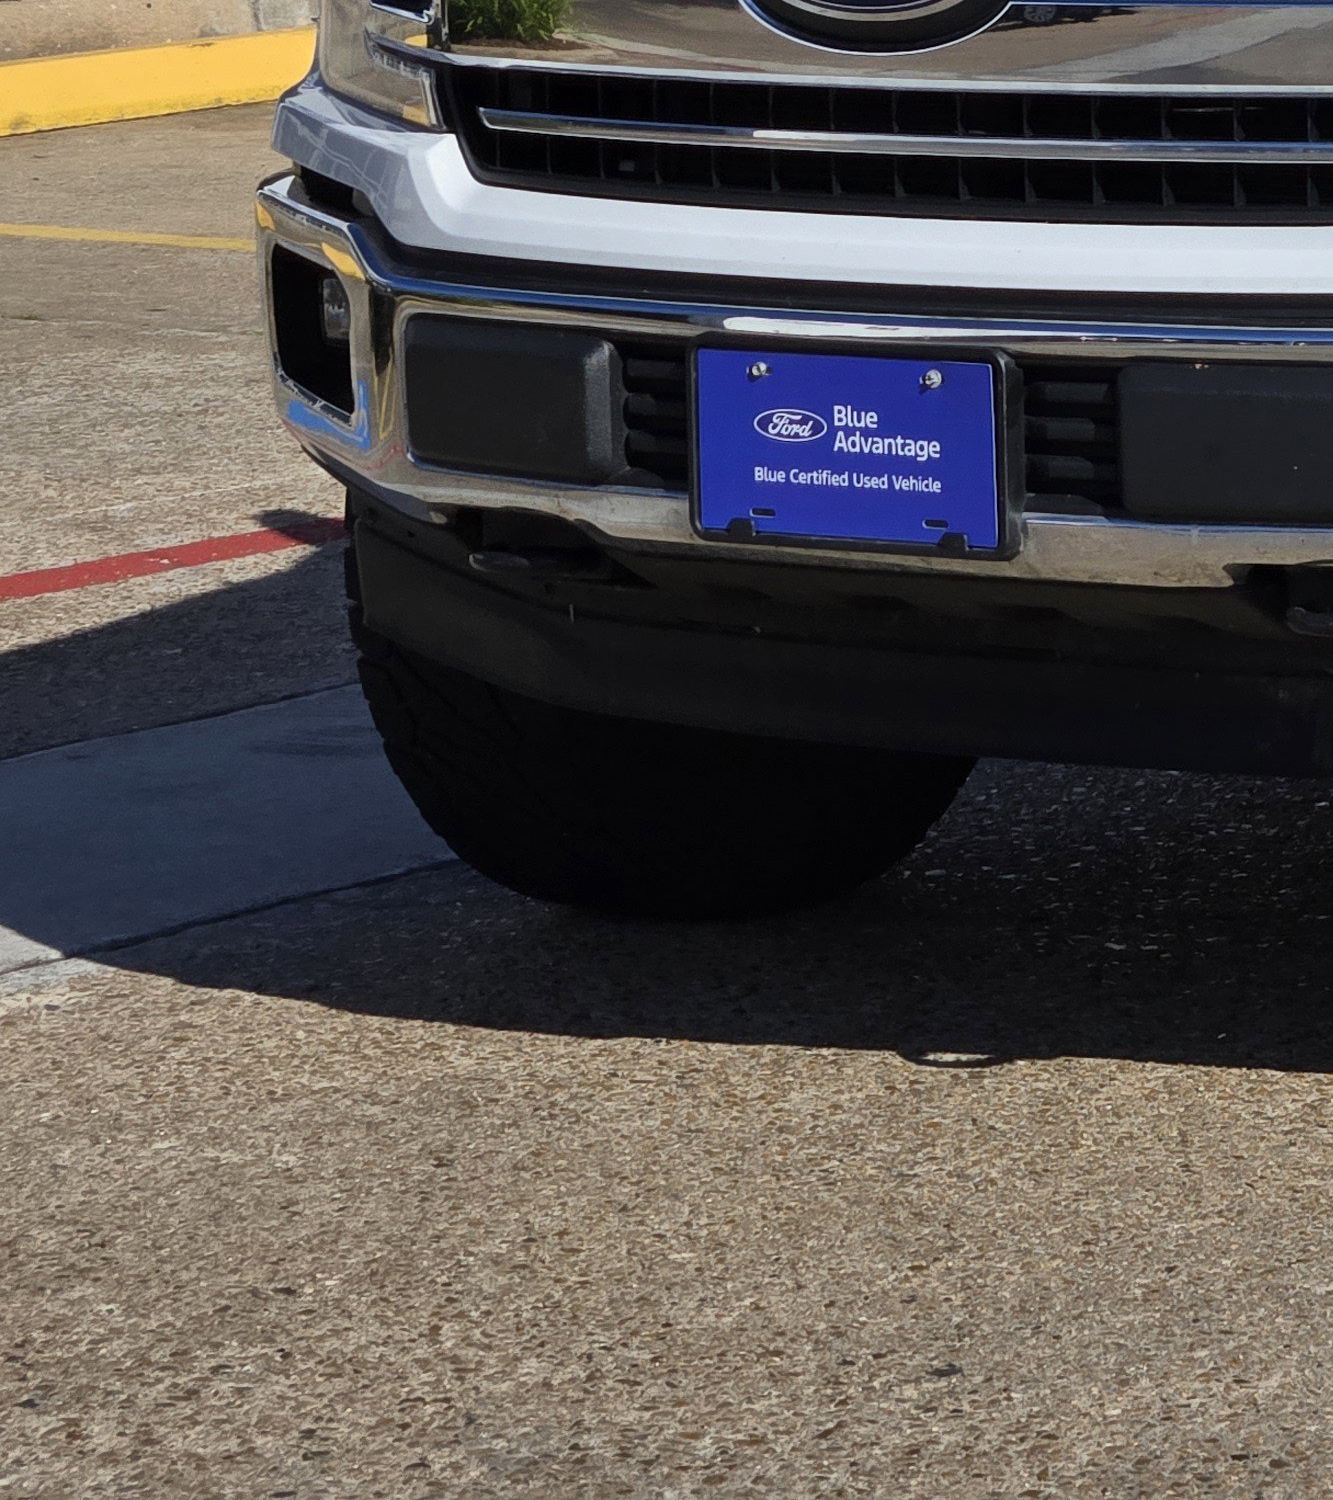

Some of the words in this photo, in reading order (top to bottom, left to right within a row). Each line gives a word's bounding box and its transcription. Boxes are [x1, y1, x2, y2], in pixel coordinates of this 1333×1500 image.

[768, 412, 814, 438] Ford
[833, 405, 878, 428] Blue
[833, 431, 941, 462] Advantage
[754, 466, 786, 483] Blue
[789, 468, 849, 487] Certified
[852, 472, 888, 490] Used
[891, 475, 942, 493] Vehicle
